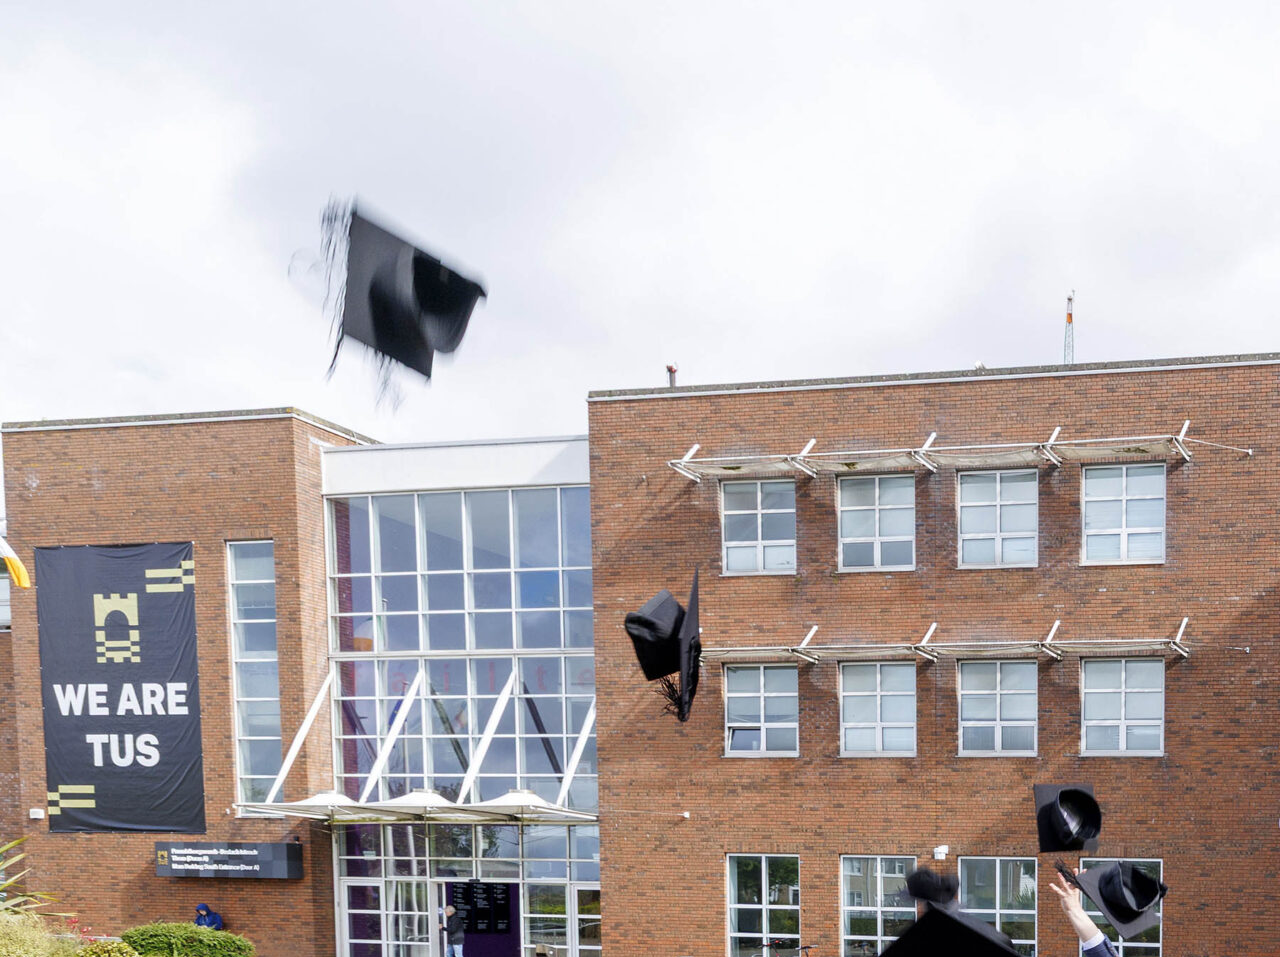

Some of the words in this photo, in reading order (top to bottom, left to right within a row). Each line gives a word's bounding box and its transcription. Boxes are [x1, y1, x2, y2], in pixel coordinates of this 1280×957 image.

[52, 683, 110, 716] WE
[116, 682, 189, 715] ARE
[85, 733, 160, 767] TUS
